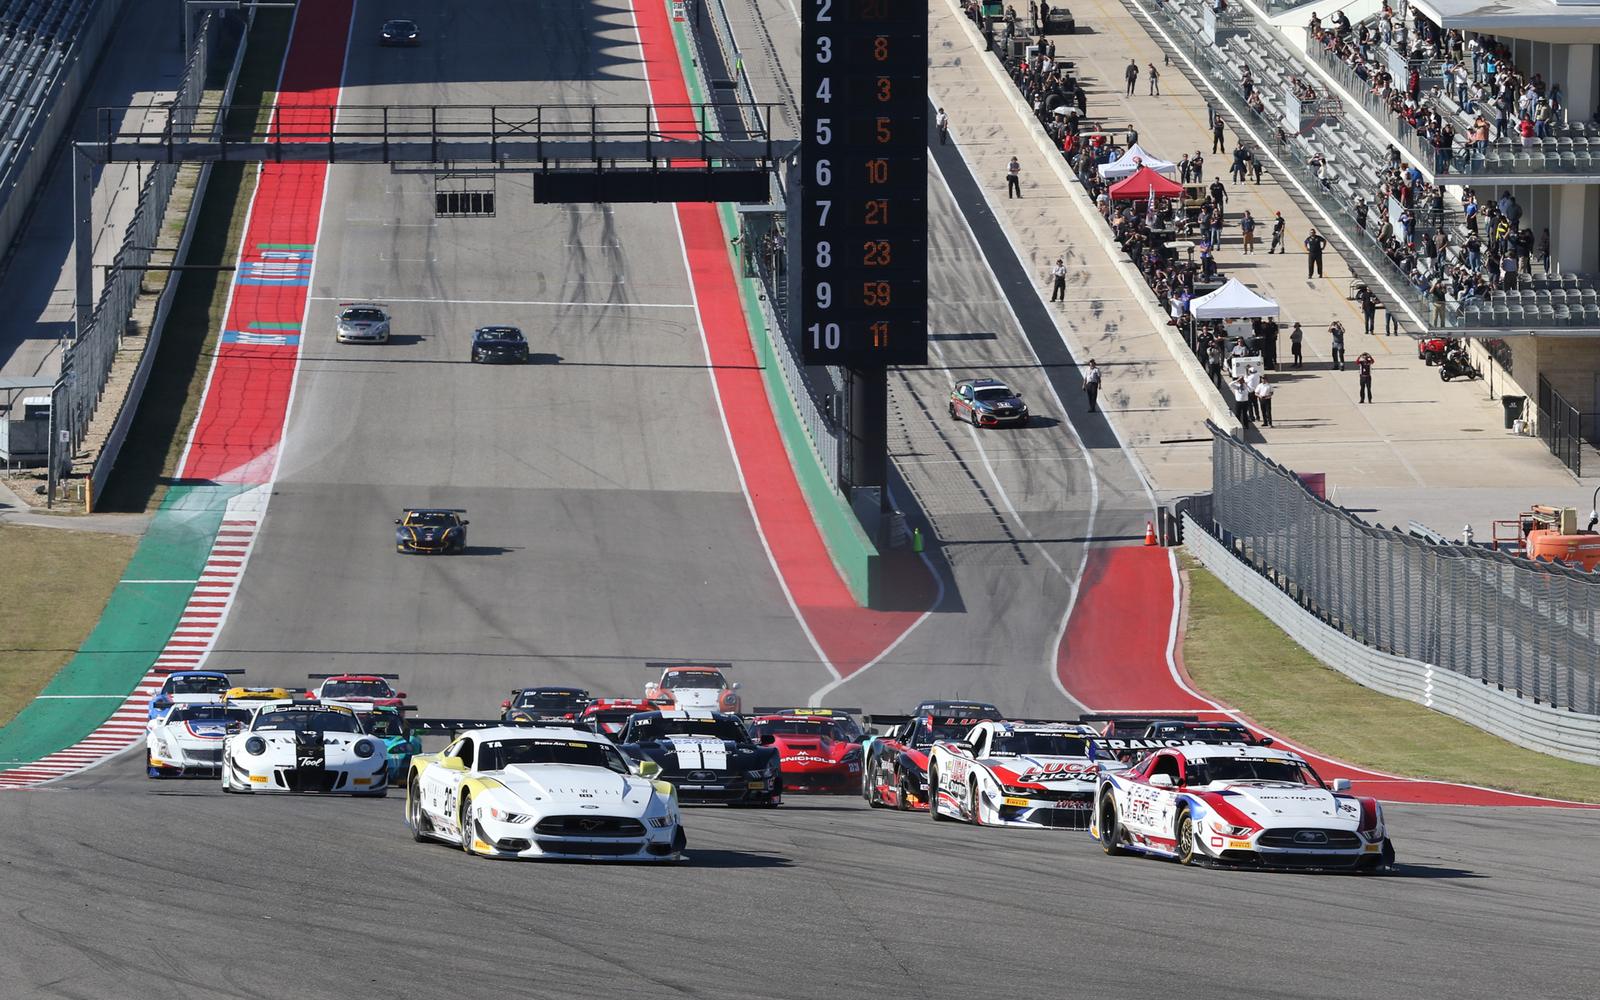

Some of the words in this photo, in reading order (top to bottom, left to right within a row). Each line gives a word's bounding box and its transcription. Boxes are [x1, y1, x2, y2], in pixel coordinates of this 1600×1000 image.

[816, 0, 832, 21] 2
[816, 36, 832, 63] 3
[874, 37, 888, 61] 8
[815, 77, 832, 104] 4
[877, 78, 891, 102] 3
[816, 118, 832, 145] 5
[877, 118, 891, 143] 5
[816, 159, 832, 186] 6
[865, 160, 888, 184] 10
[815, 200, 832, 227] 7
[864, 200, 888, 225] 21
[816, 241, 832, 268] 8
[863, 241, 891, 266] 23
[816, 282, 832, 309] 9
[863, 282, 891, 306] 59
[808, 322, 840, 350] 10
[869, 323, 889, 347] 11
[298, 756, 324, 767] Tool
[780, 756, 837, 764] cNICHOLS
[1026, 762, 1100, 775] LUCA
[1028, 773, 1098, 783] SLICKM
[444, 786, 453, 818] 20
[1006, 798, 1028, 806] PIRELLI
